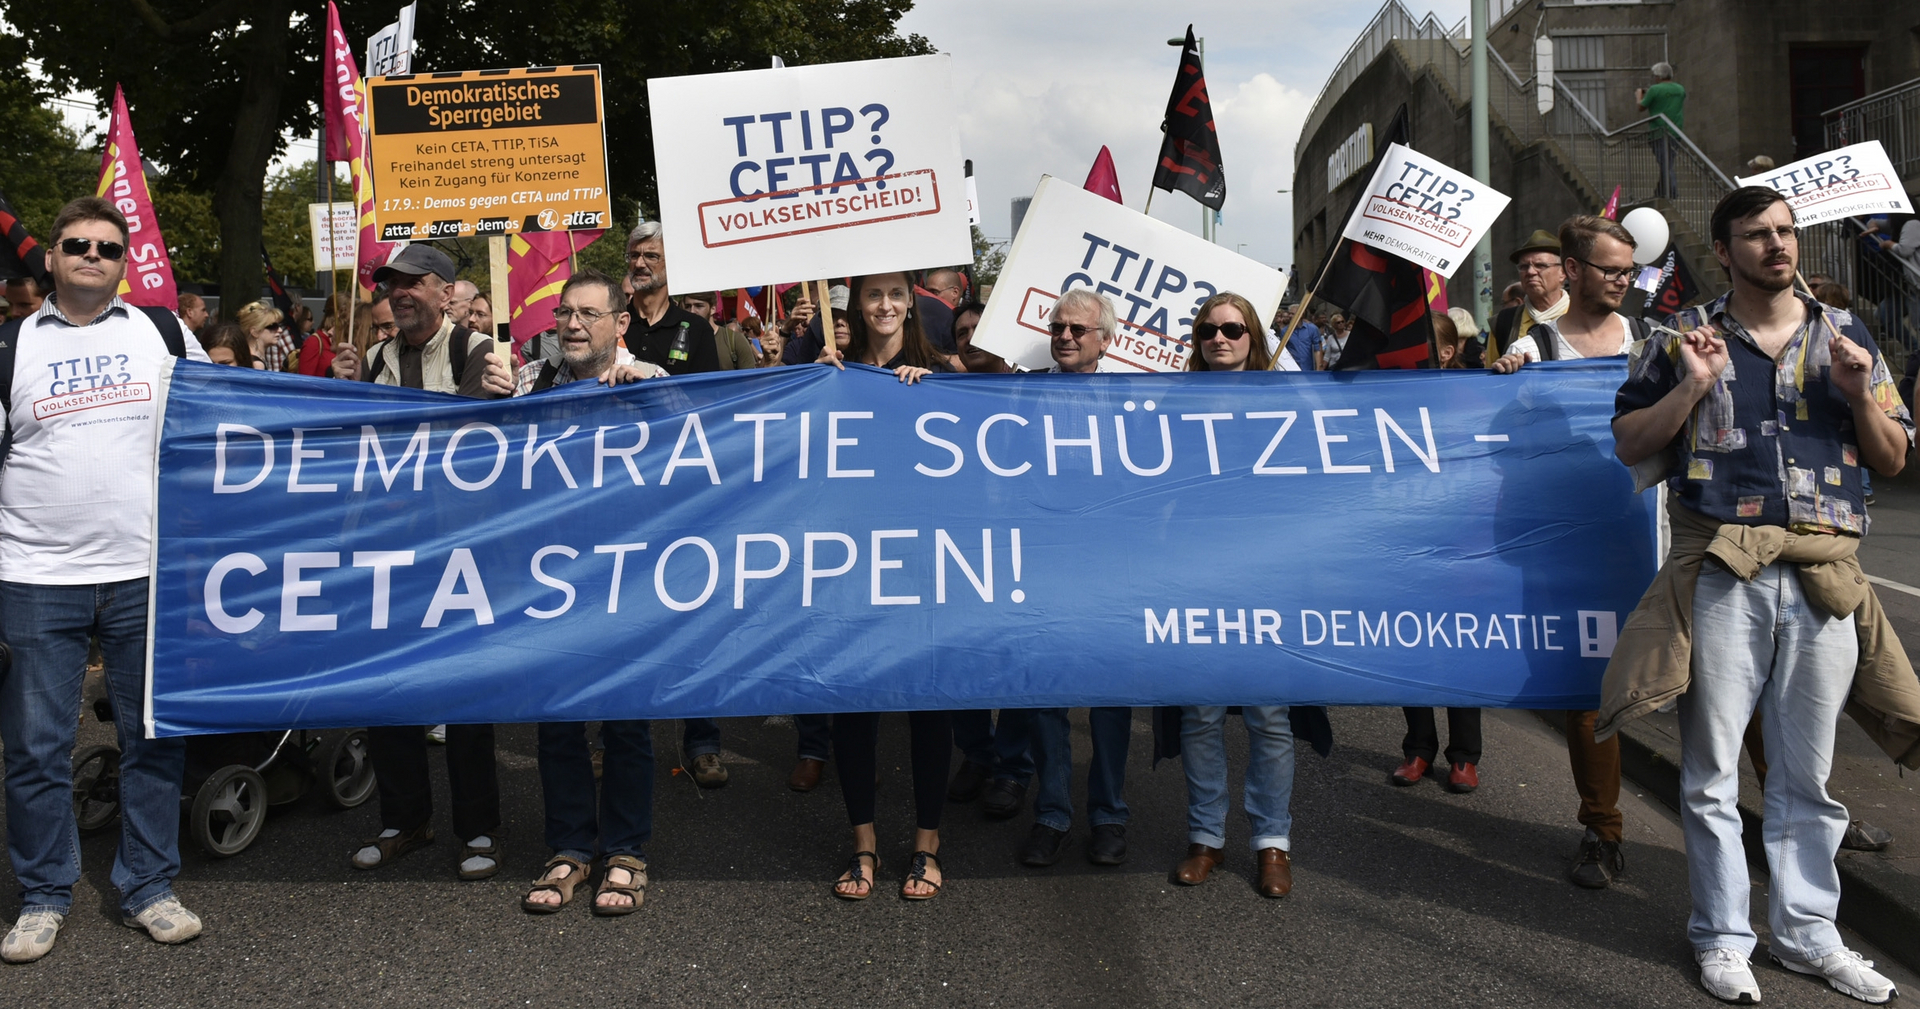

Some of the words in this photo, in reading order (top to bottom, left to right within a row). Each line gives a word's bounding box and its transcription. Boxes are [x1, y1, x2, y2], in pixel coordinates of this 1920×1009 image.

[406, 80, 560, 106] Demokratisches
[428, 102, 542, 130] Sperrgebiet
[723, 103, 890, 156] TTIP?
[416, 142, 446, 155] Kein
[451, 140, 489, 154] CETA,
[492, 138, 526, 152] TTIP,
[528, 136, 558, 149] TiSA
[390, 158, 466, 172] Freihandel
[470, 156, 514, 170] streng
[519, 152, 586, 167] untersagt
[730, 148, 894, 203] CETA?
[1764, 156, 1852, 188] TTIP?
[400, 176, 430, 188] Kein
[434, 174, 486, 188] Zugang
[490, 172, 510, 184] für
[515, 169, 580, 182] Konzerne
[1399, 161, 1474, 207] TTIP?
[382, 199, 420, 212] 17.9.:
[424, 196, 466, 210] Demos
[470, 195, 507, 209] gegen
[510, 191, 542, 204] CETA
[546, 189, 569, 202] und
[572, 187, 602, 200] TTIP
[1386, 182, 1461, 225] CETA?
[1792, 180, 1880, 206] KSENTSCHEID!
[562, 210, 604, 226] attac
[718, 186, 922, 232] VOLKSENTSCHEID!
[1372, 203, 1460, 240] VOLKSENTSCHEID!
[1796, 214, 1818, 224] EHR
[1820, 202, 1886, 218] DEMOKRATIE
[384, 218, 520, 237] attac.de/ceta-demos
[1363, 230, 1386, 242] MEHR
[1384, 236, 1437, 264] DEMOKRATIE
[130, 243, 164, 290] Sie
[1081, 232, 1217, 316] TTIP?
[47, 354, 129, 379] TTIP?
[50, 372, 132, 396] CETA?
[42, 389, 144, 412] VOLKSENTSCHEID!
[71, 414, 150, 428] www.volksentscheid.de
[213, 412, 874, 494] DEMOKRATIE
[914, 400, 1440, 477] SCHÜTZEN
[204, 548, 494, 634] CETA
[524, 528, 1026, 620] STOPPEN!
[1144, 608, 1283, 646] MEHR
[1300, 610, 1564, 651] DEMOKRATIE
